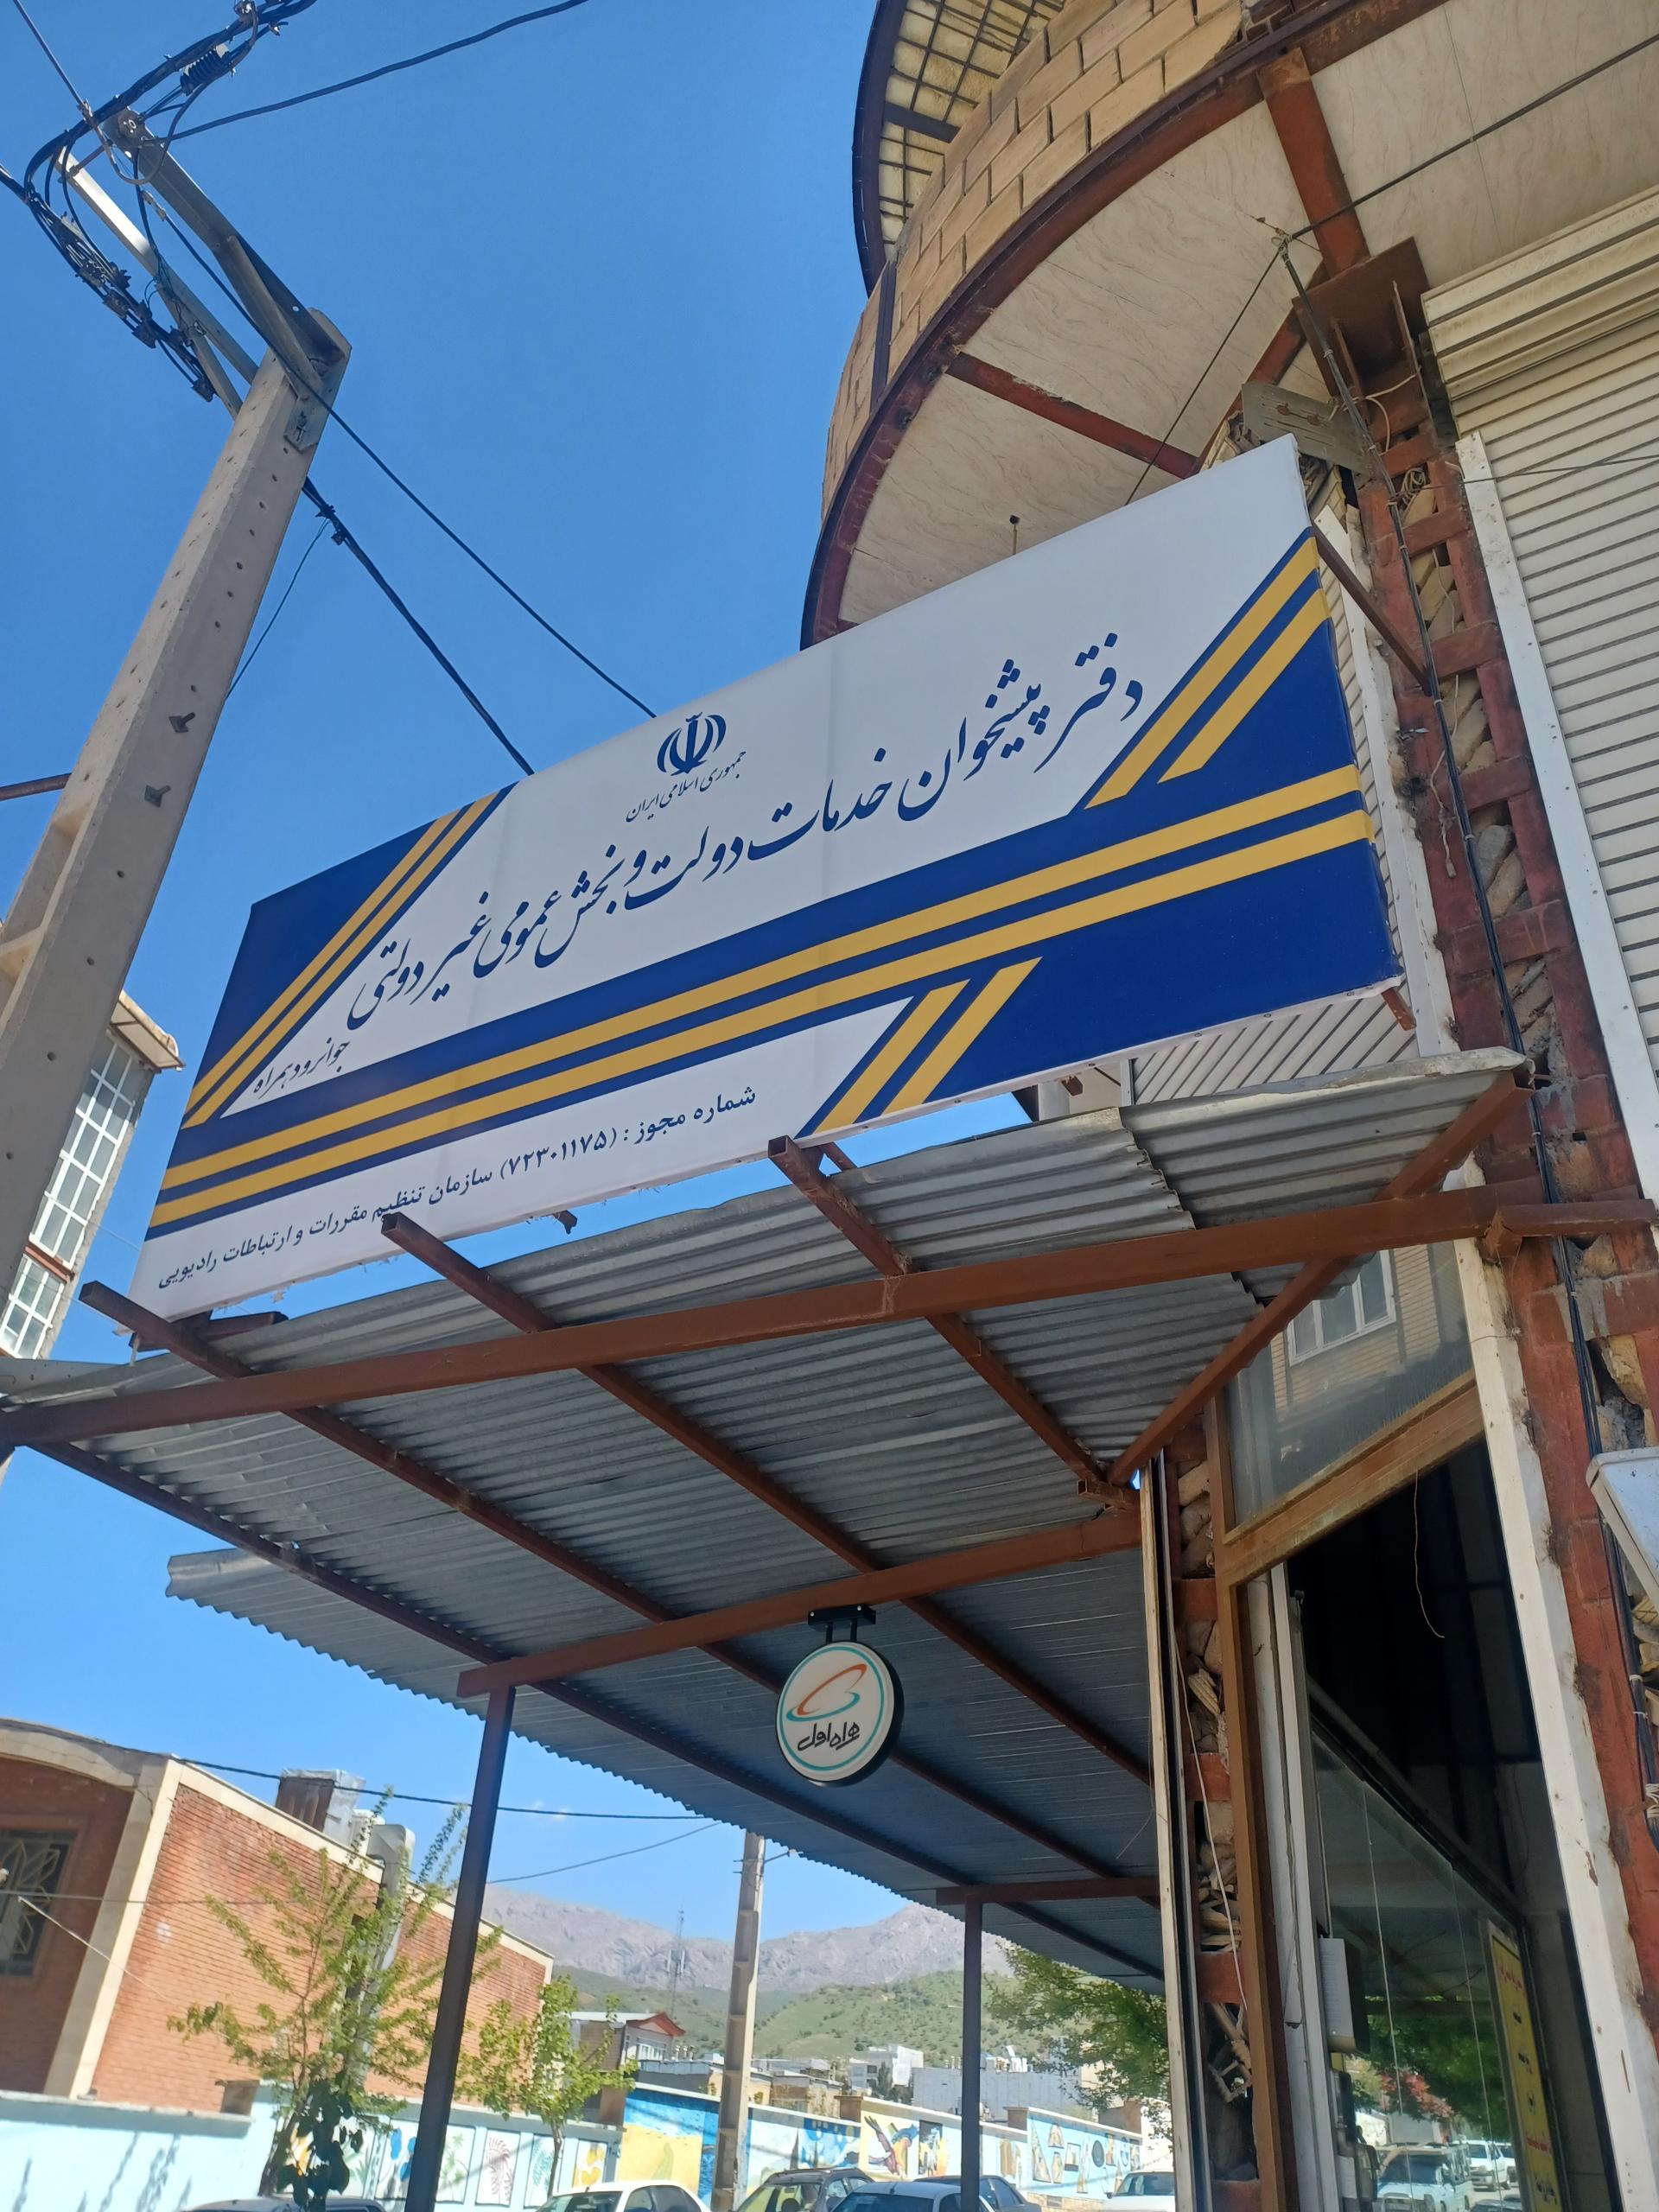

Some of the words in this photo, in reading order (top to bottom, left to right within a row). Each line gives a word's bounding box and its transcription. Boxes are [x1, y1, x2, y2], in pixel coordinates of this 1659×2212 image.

[1033, 632, 1143, 774] دفتر
[897, 658, 1051, 822] پیشخوان
[698, 750, 747, 792] جمهوری
[625, 792, 660, 823] ایران
[658, 776, 699, 809] اسلامی
[747, 747, 893, 861] خدمات
[623, 849, 647, 887] و
[624, 825, 744, 911] دولت
[534, 843, 626, 969] بخش
[409, 891, 493, 1006] غیر
[473, 890, 563, 979] عمومی
[346, 938, 425, 1031] دولتی
[289, 1037, 351, 1083] جوانرود
[693, 1086, 756, 1124] شماره
[633, 1114, 686, 1145] مجوز
[428, 1167, 493, 1205] سازمان
[292, 1230, 303, 1247] و
[308, 1205, 368, 1236] مقررات
[222, 1224, 293, 1262] ارتباطات
[158, 1250, 218, 1290] رادیویی
[796, 1721, 832, 1752] اول
